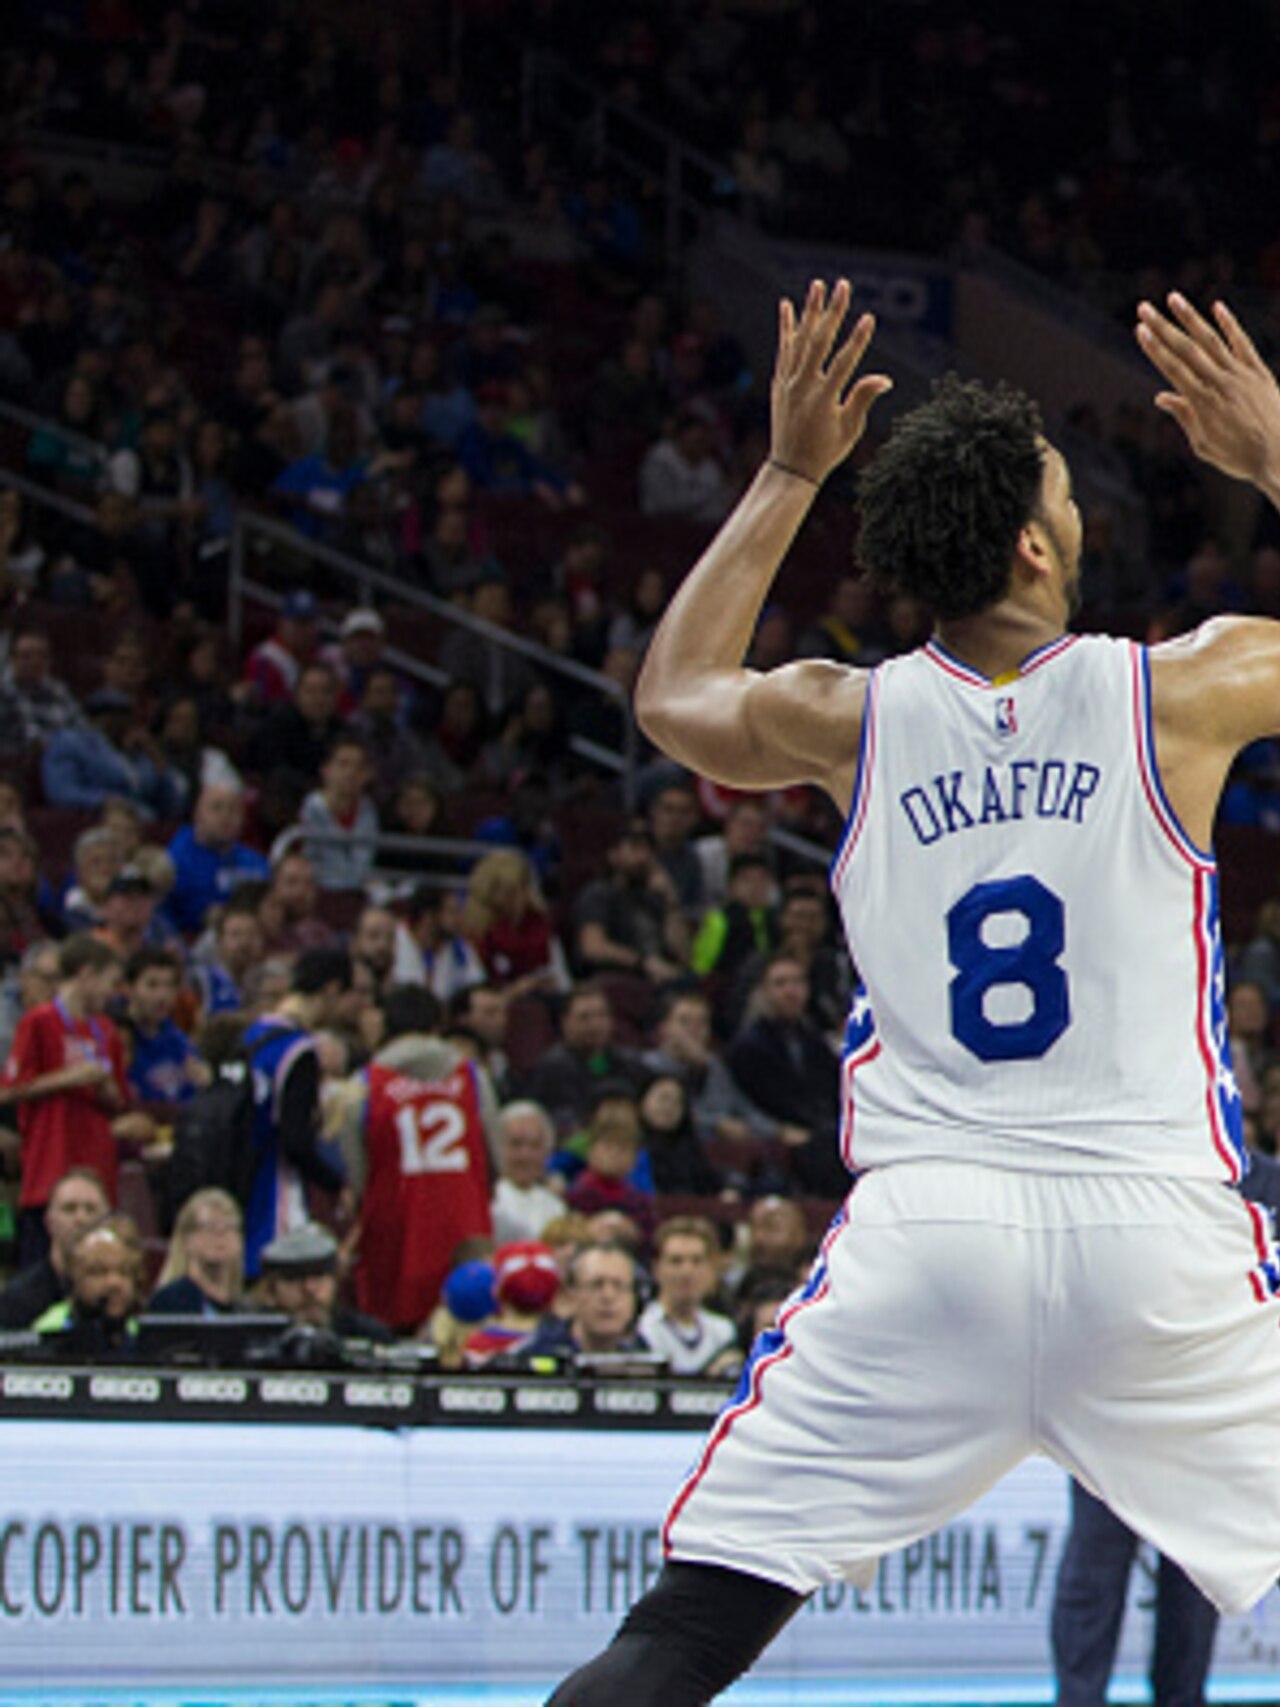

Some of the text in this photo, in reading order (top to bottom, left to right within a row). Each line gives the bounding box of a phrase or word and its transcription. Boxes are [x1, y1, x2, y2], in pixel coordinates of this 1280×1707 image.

[900, 760, 1101, 845] OKAFOR
[946, 874, 1071, 1064] 8
[395, 1101, 470, 1176] 12
[3, 1373, 71, 1397] GEICO
[0, 1522, 186, 1616] COPIER
[213, 1523, 463, 1615] PROVIDER
[491, 1525, 549, 1614] OF
